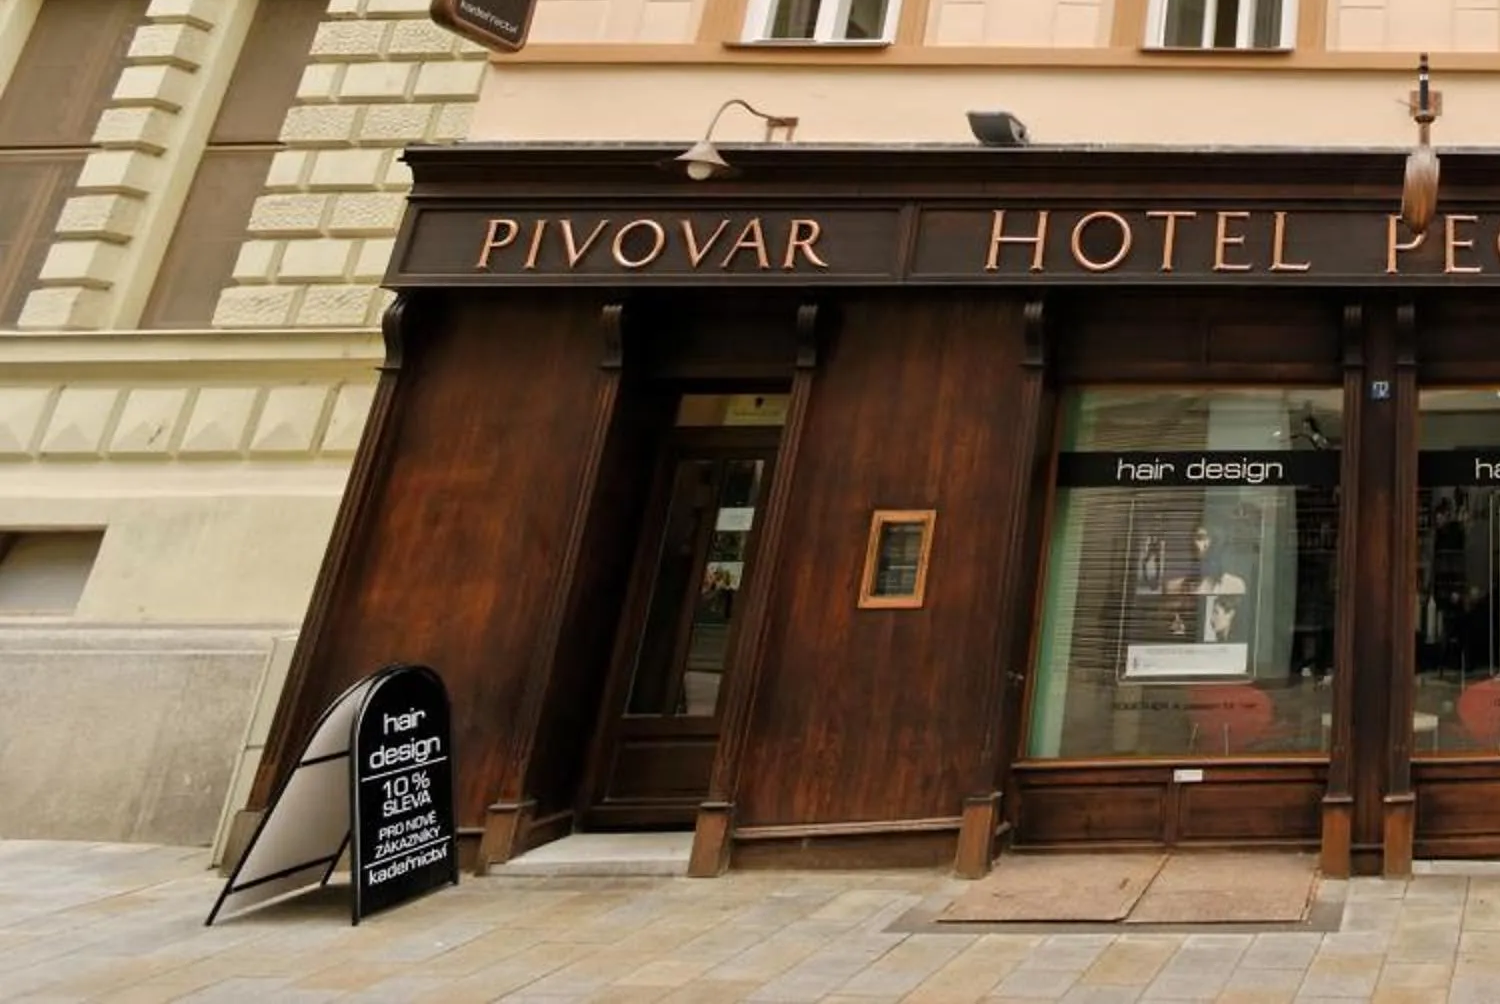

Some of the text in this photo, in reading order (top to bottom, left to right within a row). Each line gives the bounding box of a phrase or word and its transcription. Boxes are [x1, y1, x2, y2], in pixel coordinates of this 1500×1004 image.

[475, 217, 829, 270] PIVOVAR
[982, 209, 1312, 273] HOTEL
[1116, 457, 1284, 484] hair design
[383, 707, 426, 735] hair
[369, 736, 441, 770] design
[382, 771, 431, 799] 10 %
[383, 791, 432, 818] SLEVA
[379, 810, 438, 841] PRO NOVÉ
